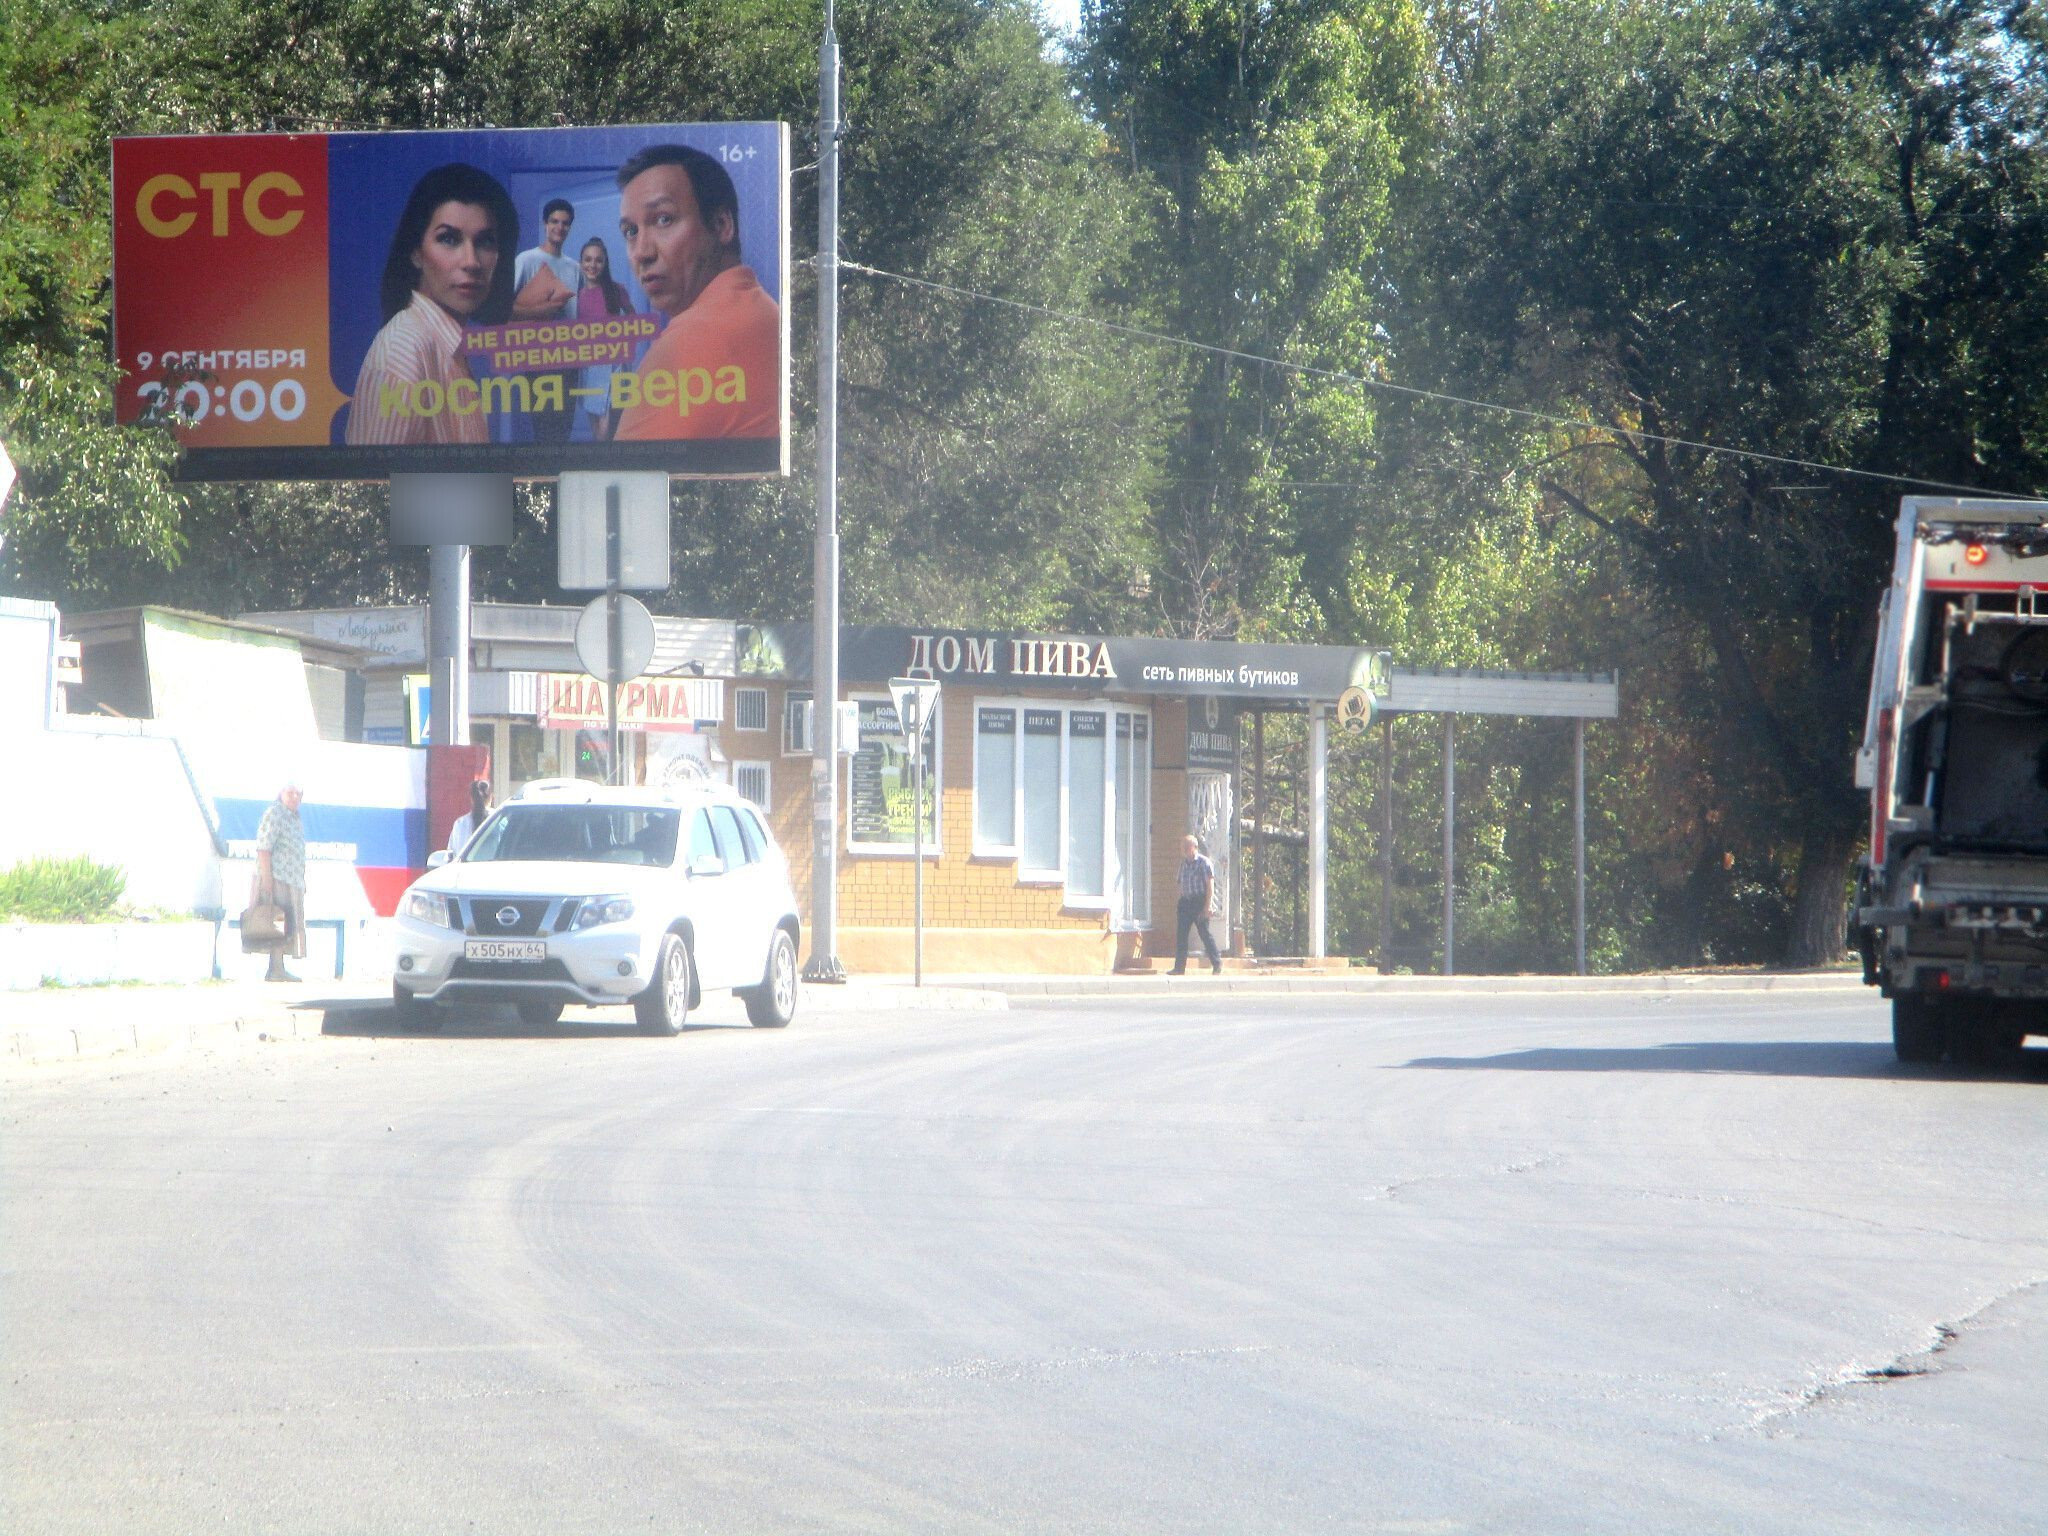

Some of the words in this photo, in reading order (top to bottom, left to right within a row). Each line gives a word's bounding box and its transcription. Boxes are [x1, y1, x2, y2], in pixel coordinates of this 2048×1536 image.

[719, 144, 757, 162] 16+
[136, 171, 305, 238] СТС
[466, 331, 498, 350] НЕ
[505, 319, 656, 346] ПРОВОРОНЬ
[137, 352, 153, 370] 9
[161, 349, 306, 370] СЕНТЯБРЯ
[494, 342, 630, 369] ПРЕМЬЕРУ!
[137, 378, 306, 423] 20:00
[906, 635, 998, 680] ДОМ
[1010, 639, 1118, 678] ПИВА
[1143, 665, 1175, 681] сеть
[1178, 666, 1235, 683] пивных
[1239, 664, 1299, 688] бутиков
